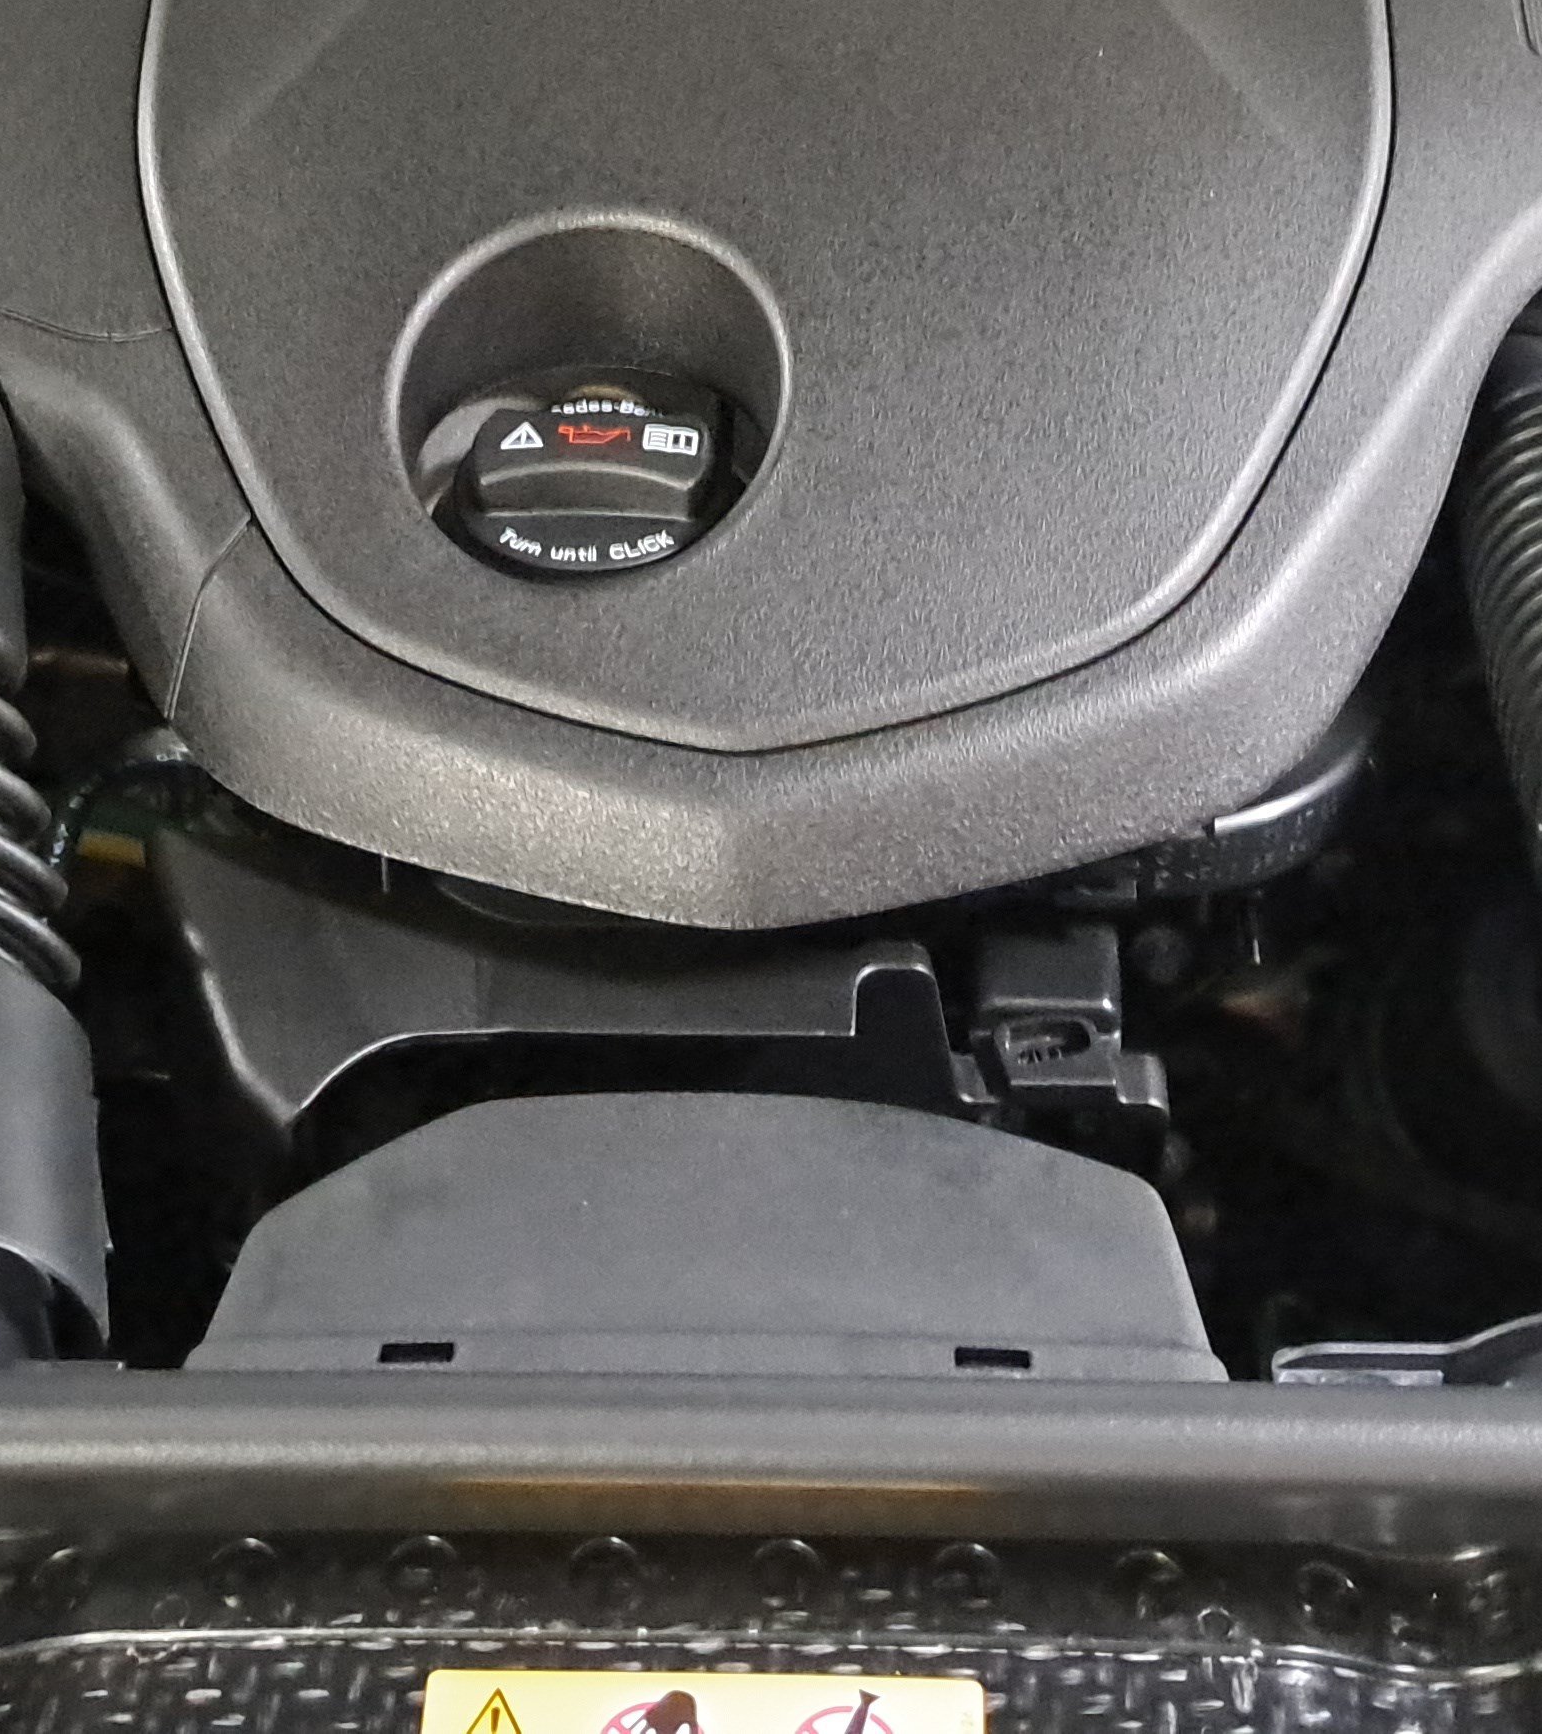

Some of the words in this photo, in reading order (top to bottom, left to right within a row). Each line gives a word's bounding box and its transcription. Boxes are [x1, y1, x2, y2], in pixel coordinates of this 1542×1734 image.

[498, 525, 543, 558] Turn
[550, 543, 598, 563] until
[608, 528, 676, 561] CLICK
